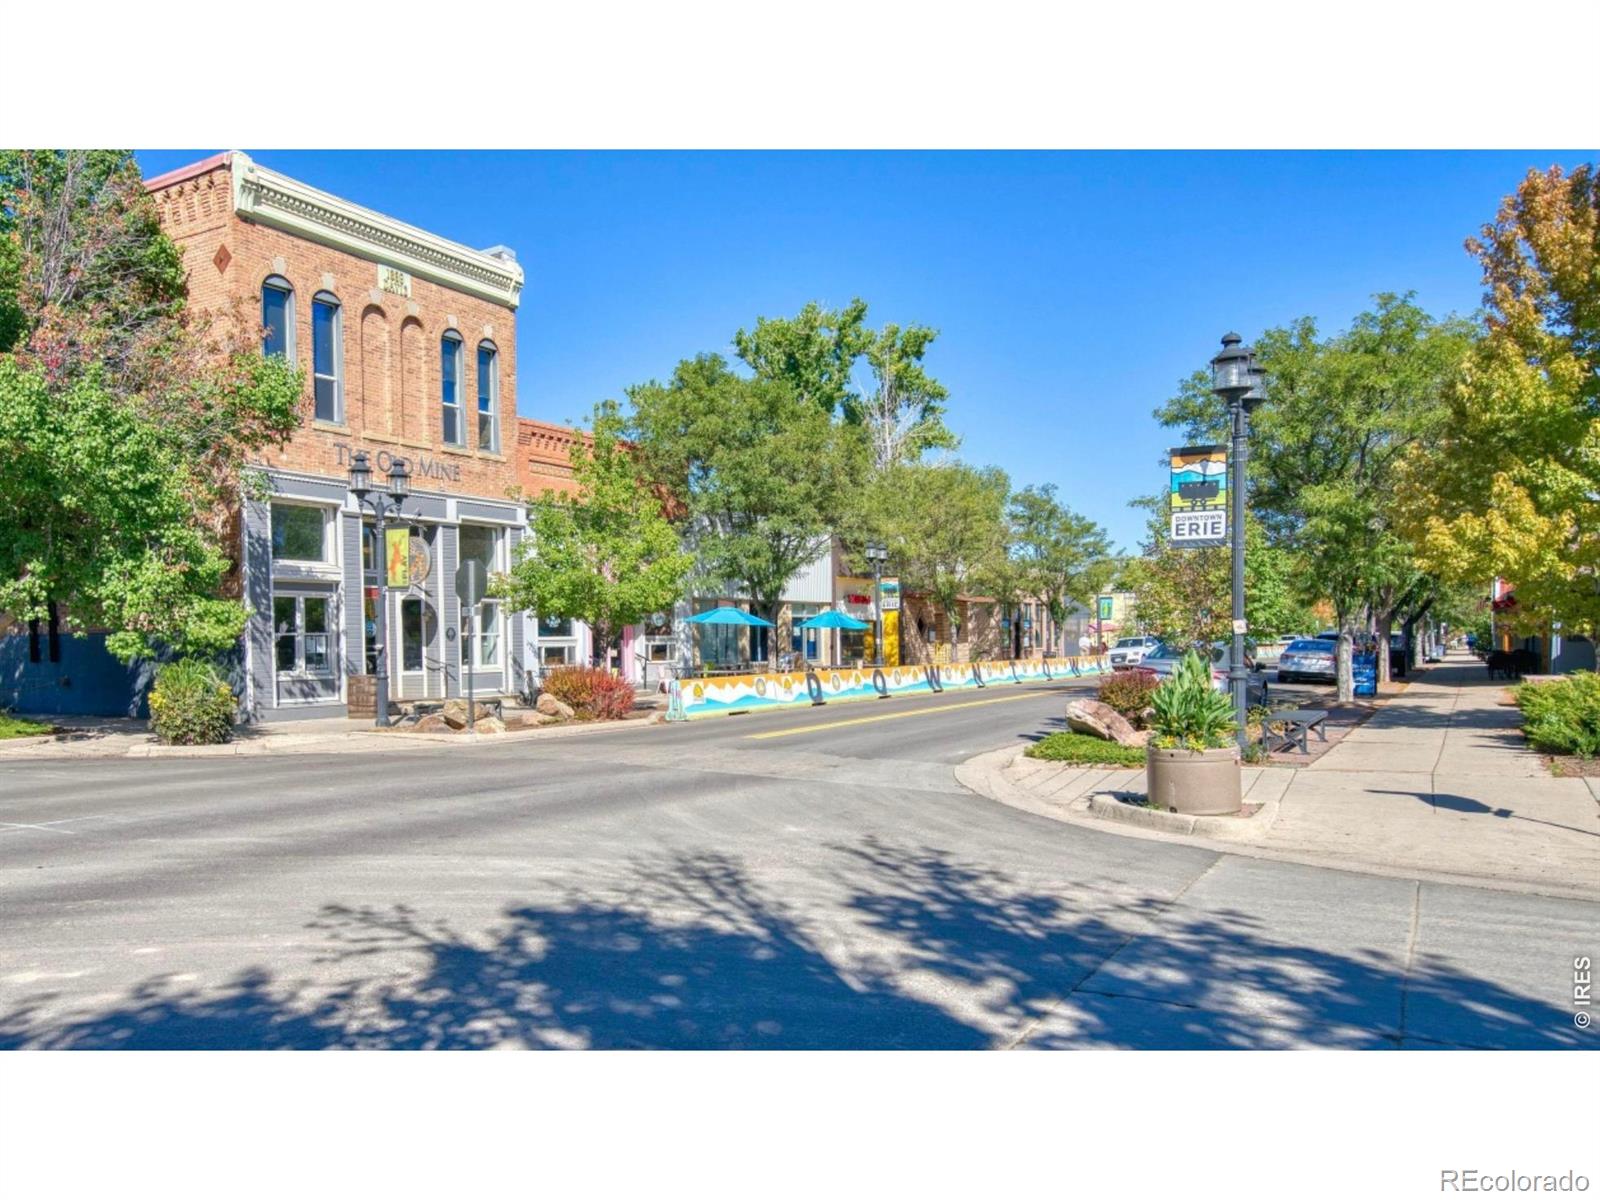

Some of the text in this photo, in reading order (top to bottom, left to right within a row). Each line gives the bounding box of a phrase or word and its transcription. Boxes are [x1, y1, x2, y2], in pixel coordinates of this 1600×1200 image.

[418, 456, 460, 482] MINE
[1175, 513, 1223, 523] DOWNTOWN
[1175, 521, 1222, 537] ERIE
